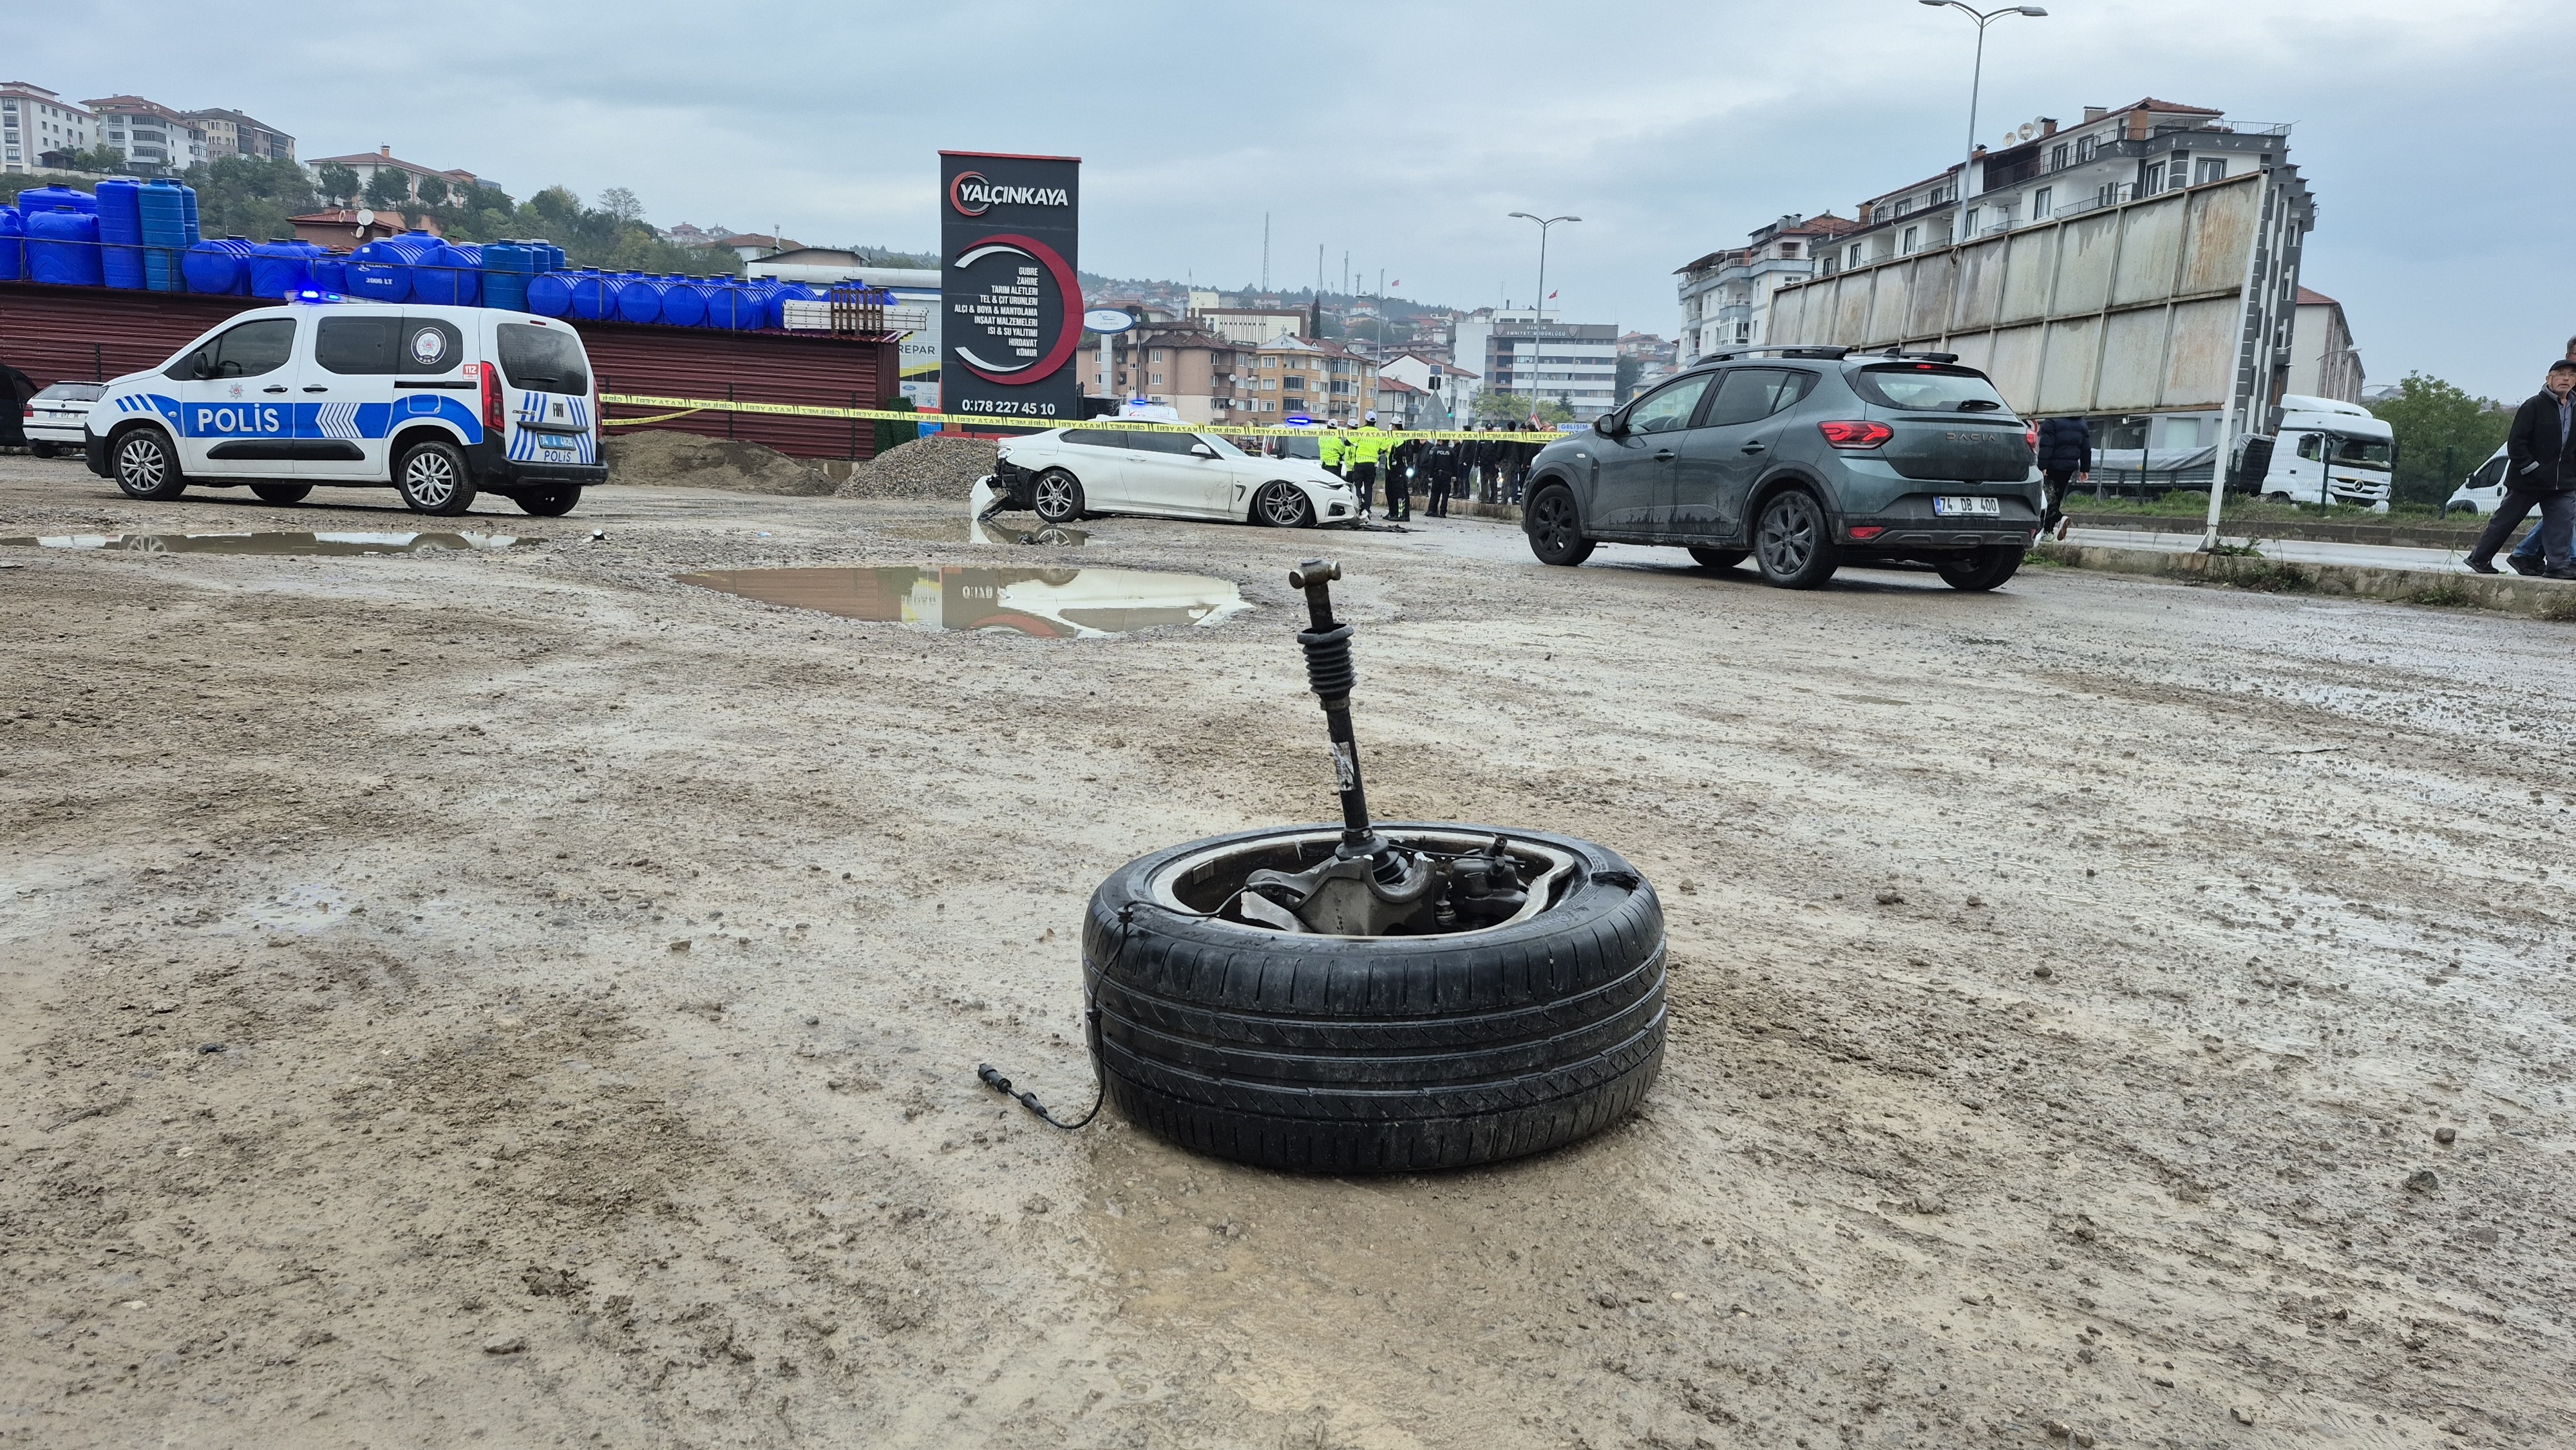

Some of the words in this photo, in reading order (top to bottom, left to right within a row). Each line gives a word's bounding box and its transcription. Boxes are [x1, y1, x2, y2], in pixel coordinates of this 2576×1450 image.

[960, 184, 1069, 206] YALÇINKAYA
[991, 285, 1010, 294] TARIM
[980, 294, 990, 303] TEL
[992, 295, 998, 304] &
[954, 304, 968, 314] ALÇI
[969, 305, 975, 313] &
[977, 305, 992, 314] BOYA
[993, 306, 999, 314] &
[1000, 306, 1038, 317] MANTOLAMA
[987, 326, 996, 335] ISI
[997, 327, 1003, 335] &
[1003, 327, 1012, 335] SU
[1012, 328, 1038, 337] YALITIMI
[1009, 337, 1038, 348] HIRDAVAT
[464, 365, 477, 373] 112
[996, 401, 1019, 413] 227
[1021, 402, 1037, 415] 45
[1040, 403, 1056, 415] 10
[198, 402, 279, 432] POLİS
[540, 435, 549, 445] 74
[553, 435, 558, 445] A
[1946, 432, 1995, 442] DACIA
[544, 450, 571, 462] POLİS
[1940, 498, 1953, 511] 74
[1960, 498, 1973, 511] DB
[1980, 498, 1996, 512] 400
